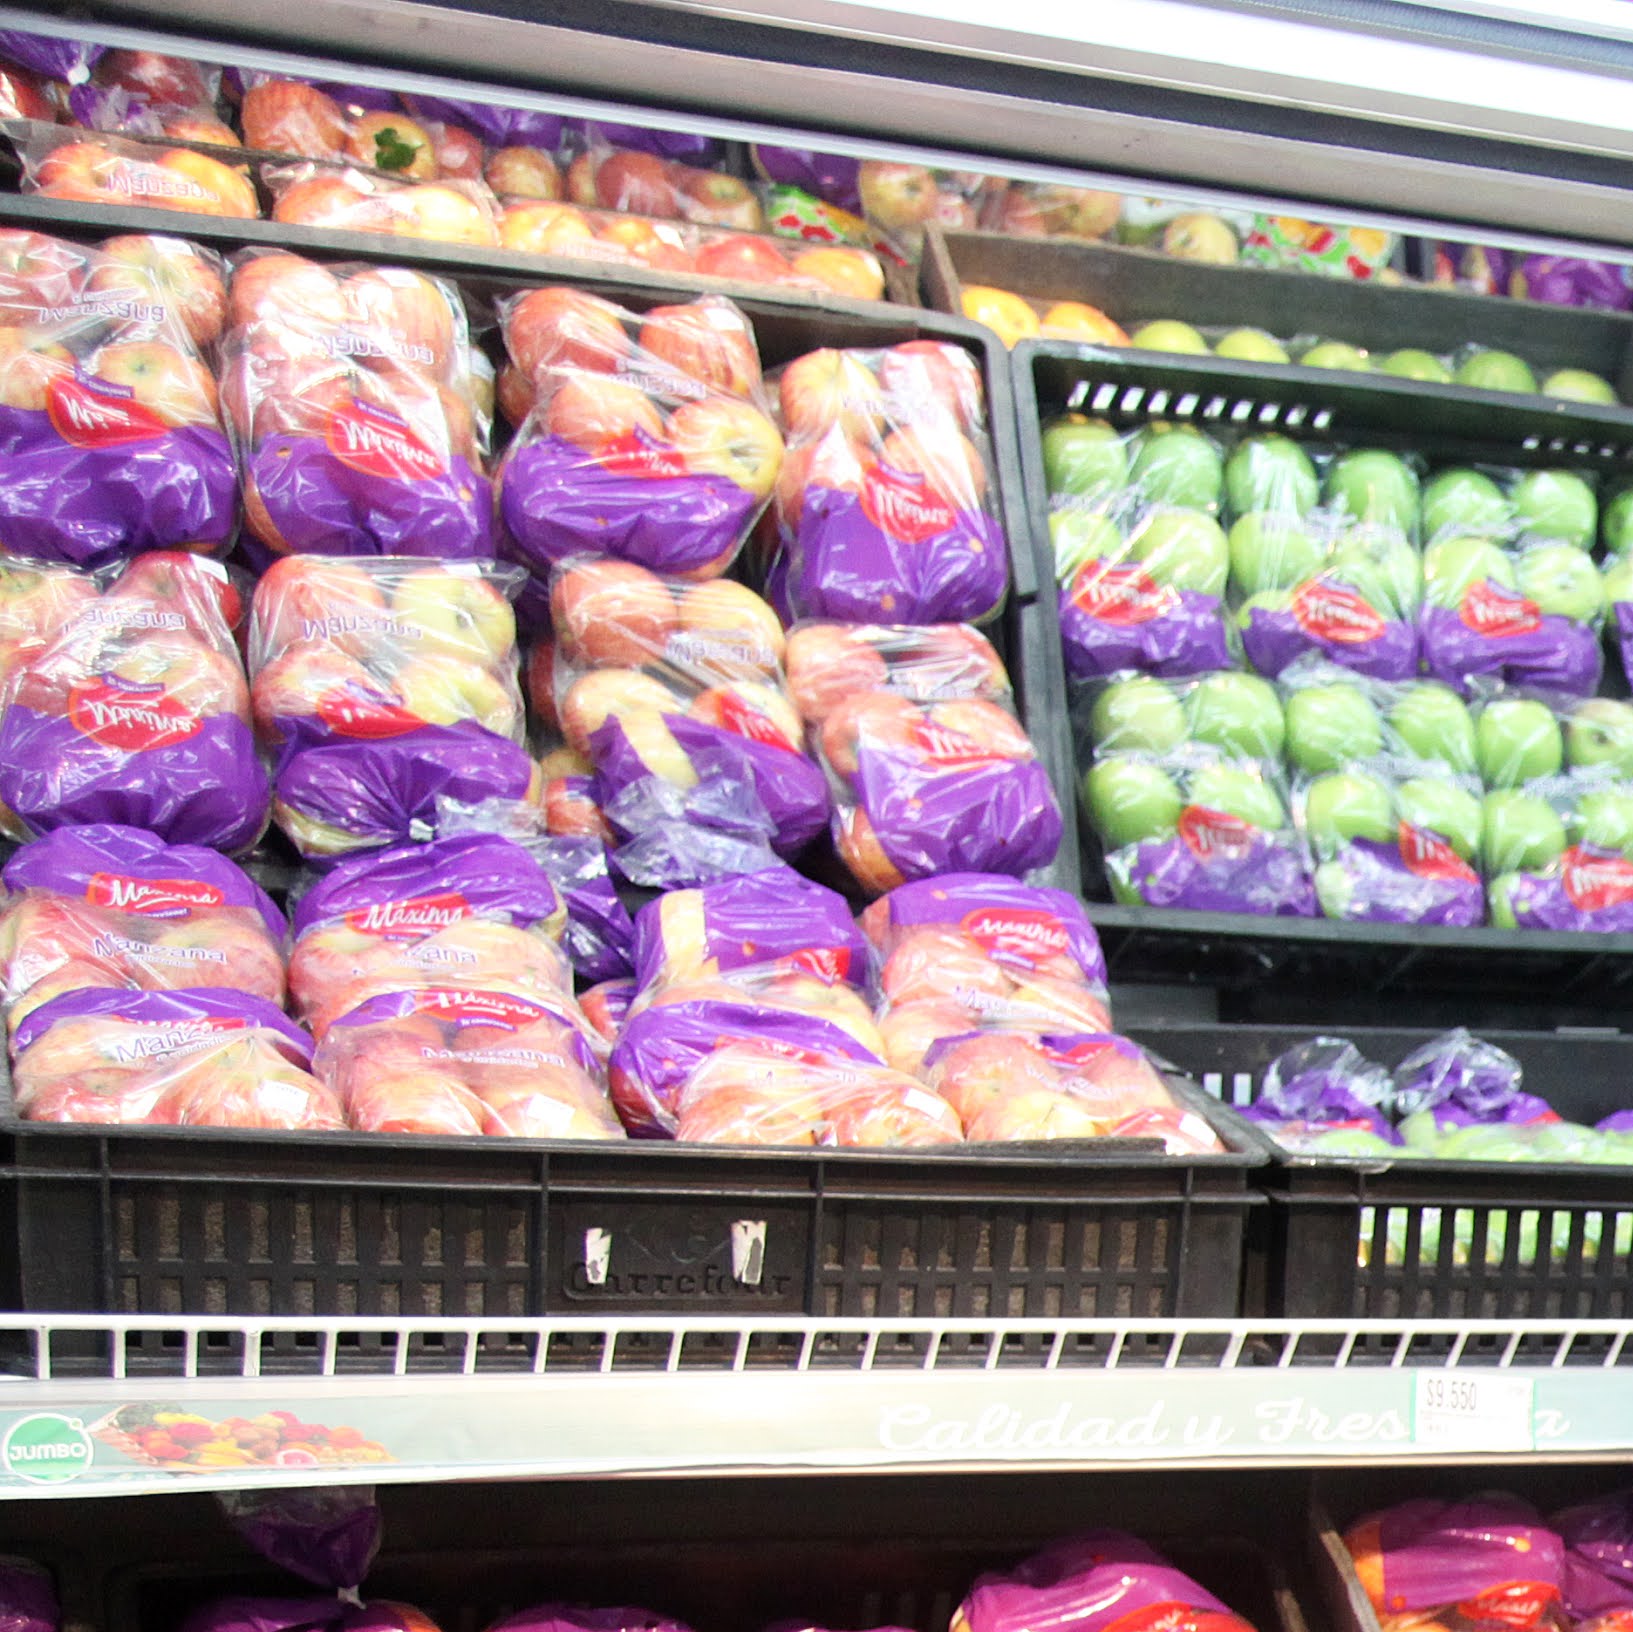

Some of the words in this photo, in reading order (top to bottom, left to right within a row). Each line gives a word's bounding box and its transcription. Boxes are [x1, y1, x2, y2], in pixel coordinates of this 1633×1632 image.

[361, 902, 463, 930] Máxima
[1426, 1379, 1478, 1411] $9.550
[876, 1400, 1170, 1452] Calidad
[1182, 1412, 1234, 1447] y
[9, 1443, 87, 1461] JUMBO
